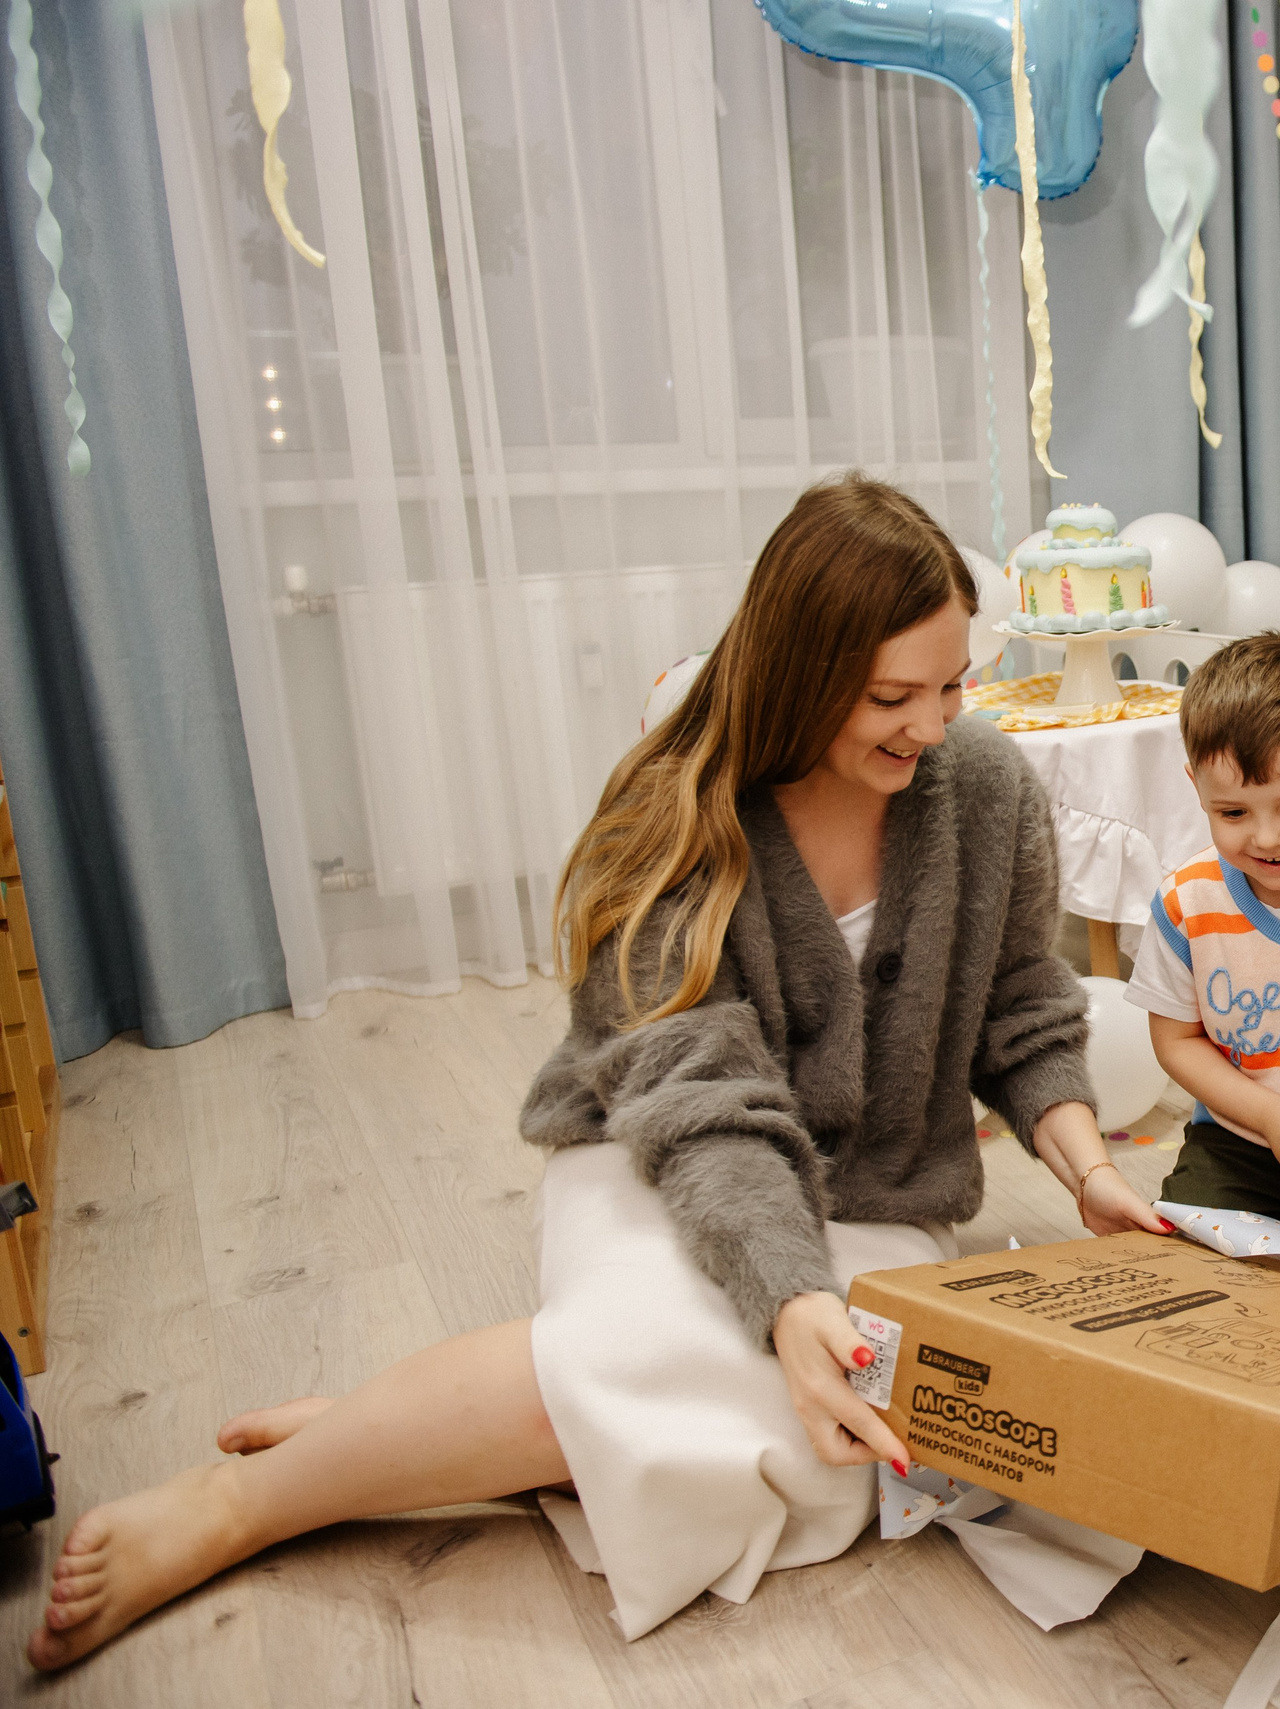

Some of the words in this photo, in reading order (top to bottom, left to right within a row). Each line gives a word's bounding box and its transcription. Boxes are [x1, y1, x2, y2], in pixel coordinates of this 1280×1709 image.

[989, 1268, 1159, 1309] MICROSCOPE
[1024, 1293, 1105, 1316] МИКРОСКОП
[1118, 1277, 1179, 1295] НАБОРОМ
[932, 1352, 983, 1378] BRAUBERG
[957, 1378, 981, 1393] kids
[912, 1384, 1058, 1458] MICROSCOPE
[907, 1431, 1024, 1483] МИКРОПРЕПАРАТОВ
[909, 1415, 982, 1450] МИКРОСКОП
[993, 1445, 1056, 1476] НАБОРОМ
